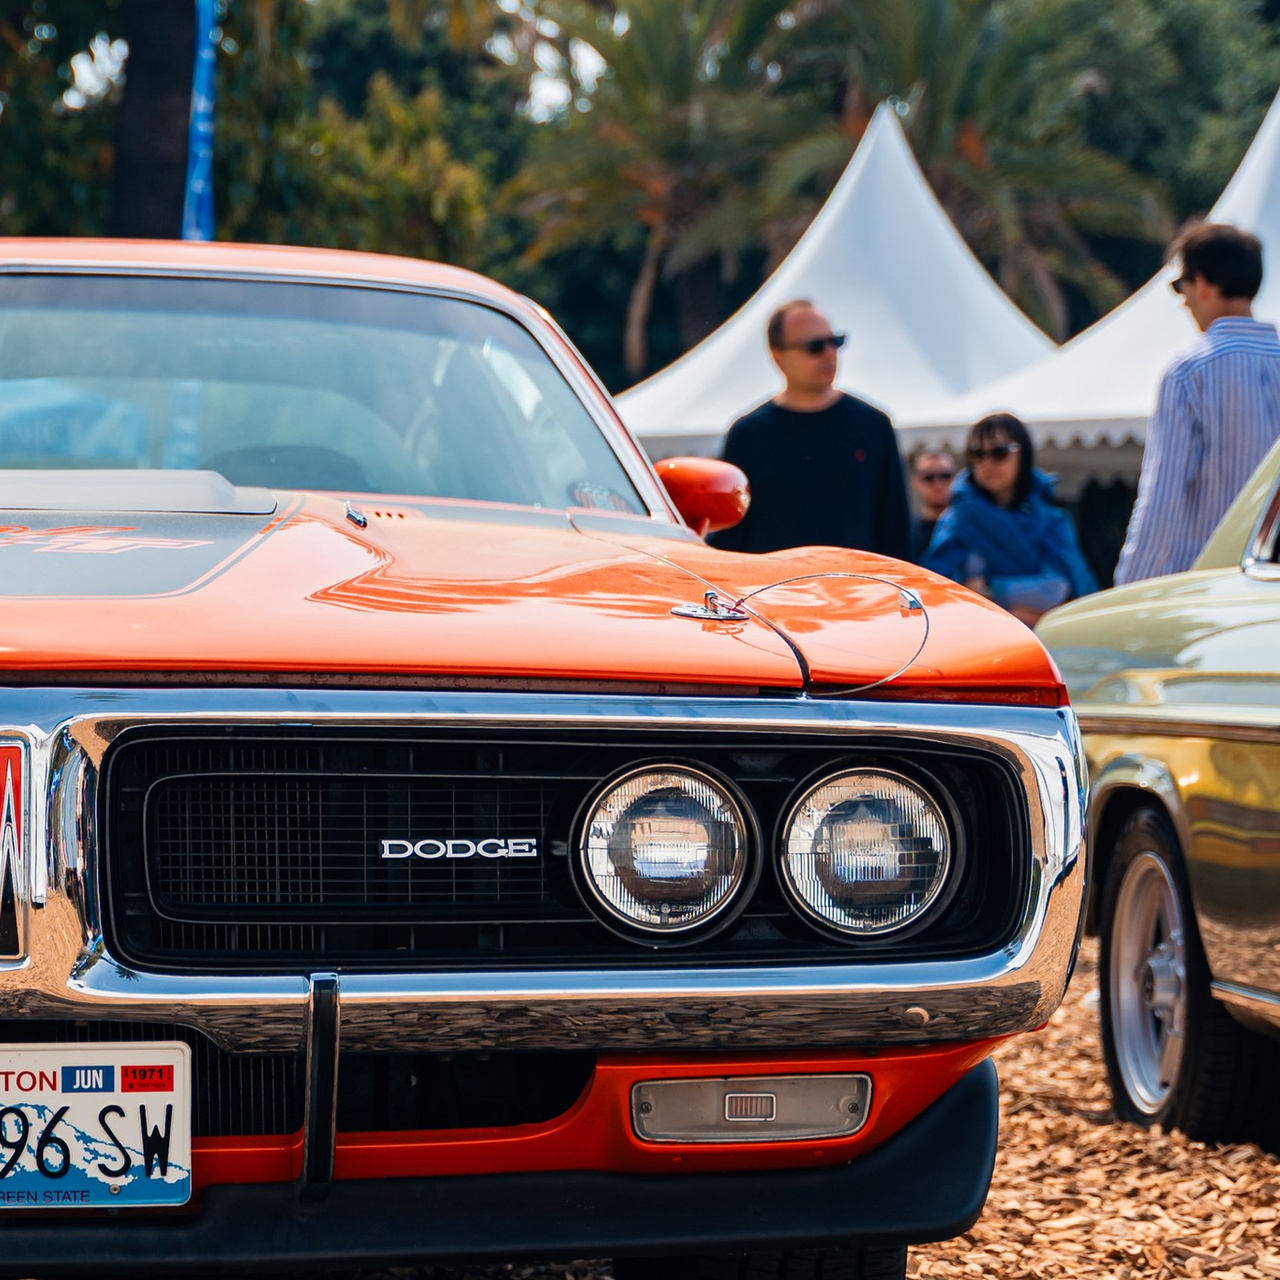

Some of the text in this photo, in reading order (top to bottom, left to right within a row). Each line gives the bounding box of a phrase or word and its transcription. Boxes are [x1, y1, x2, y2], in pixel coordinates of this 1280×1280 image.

[381, 838, 537, 859] DODGE
[73, 1069, 103, 1089] JUN
[130, 1068, 163, 1080] 1971
[98, 1104, 174, 1179] SW
[41, 1190, 91, 1204] STATE
